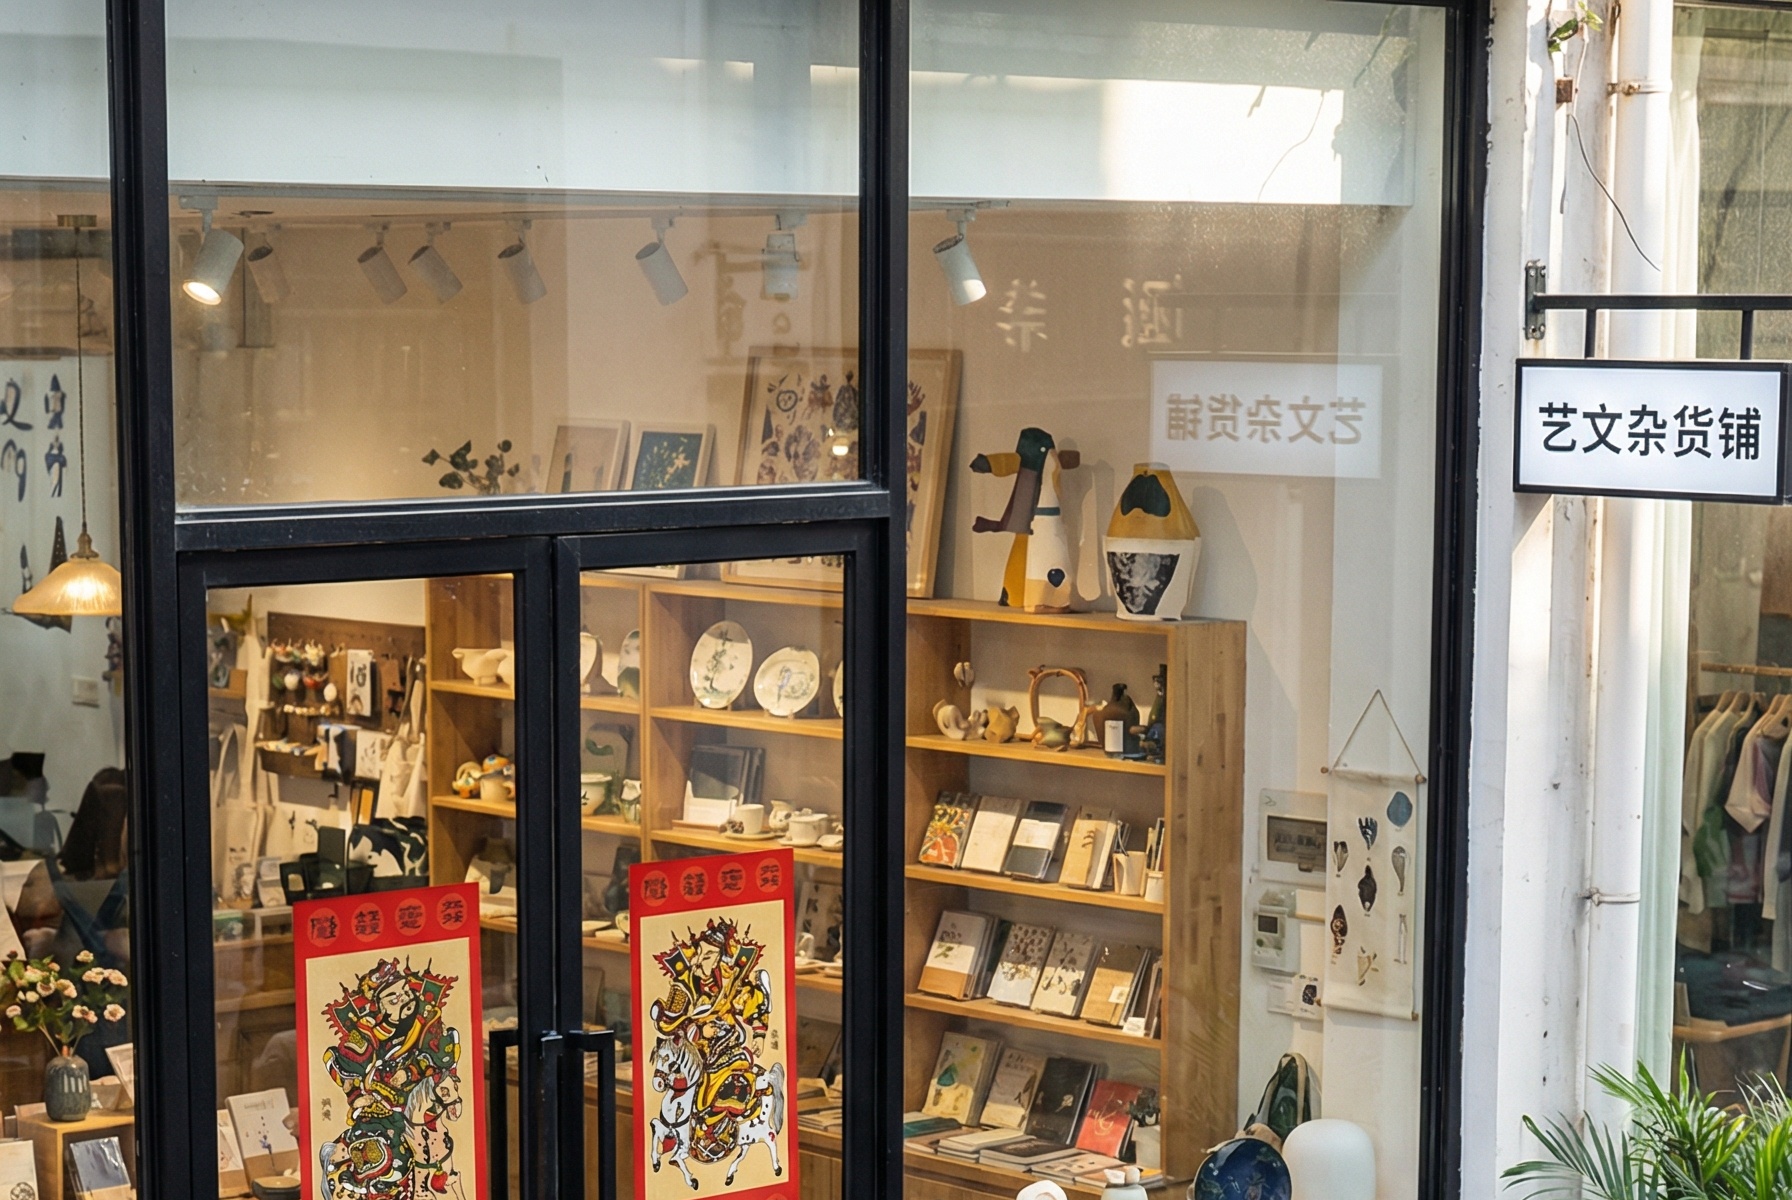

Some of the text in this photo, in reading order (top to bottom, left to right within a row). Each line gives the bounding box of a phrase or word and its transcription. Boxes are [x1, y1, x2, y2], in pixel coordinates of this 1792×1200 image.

[1539, 402, 1761, 460] 艺文杂货铺
